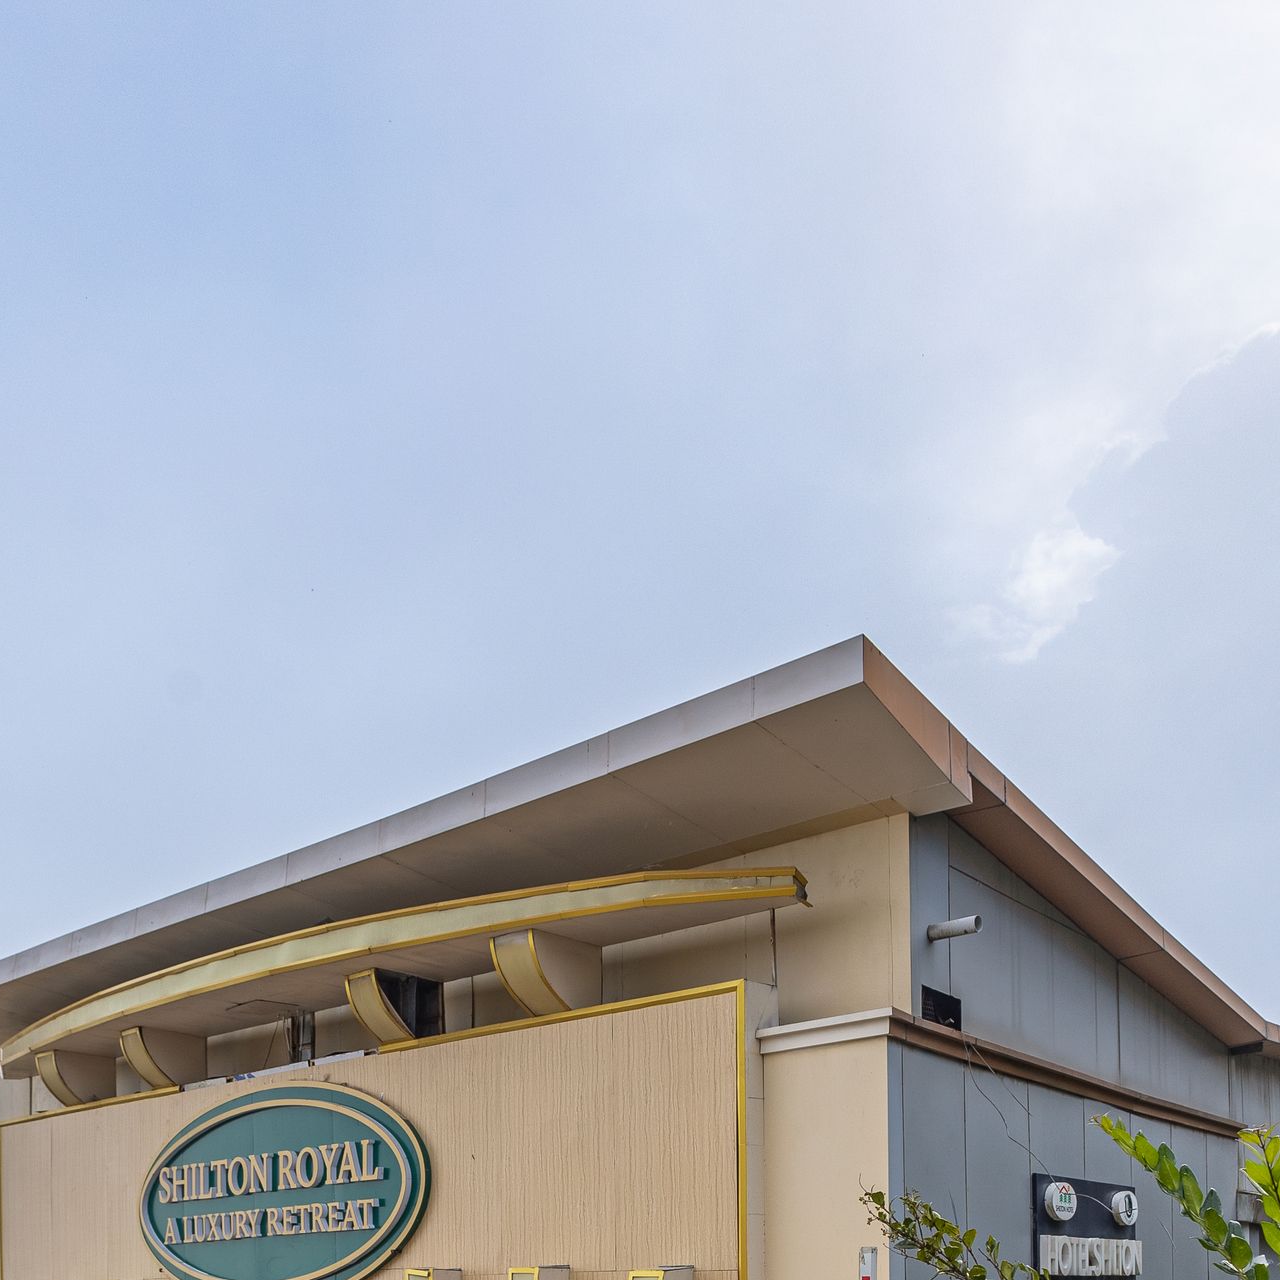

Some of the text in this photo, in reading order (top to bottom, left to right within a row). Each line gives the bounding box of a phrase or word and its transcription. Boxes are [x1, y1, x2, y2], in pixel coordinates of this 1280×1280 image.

[158, 1139, 383, 1204] SHILTON ROYAL
[164, 1198, 380, 1245] A LUXURY RETREAT
